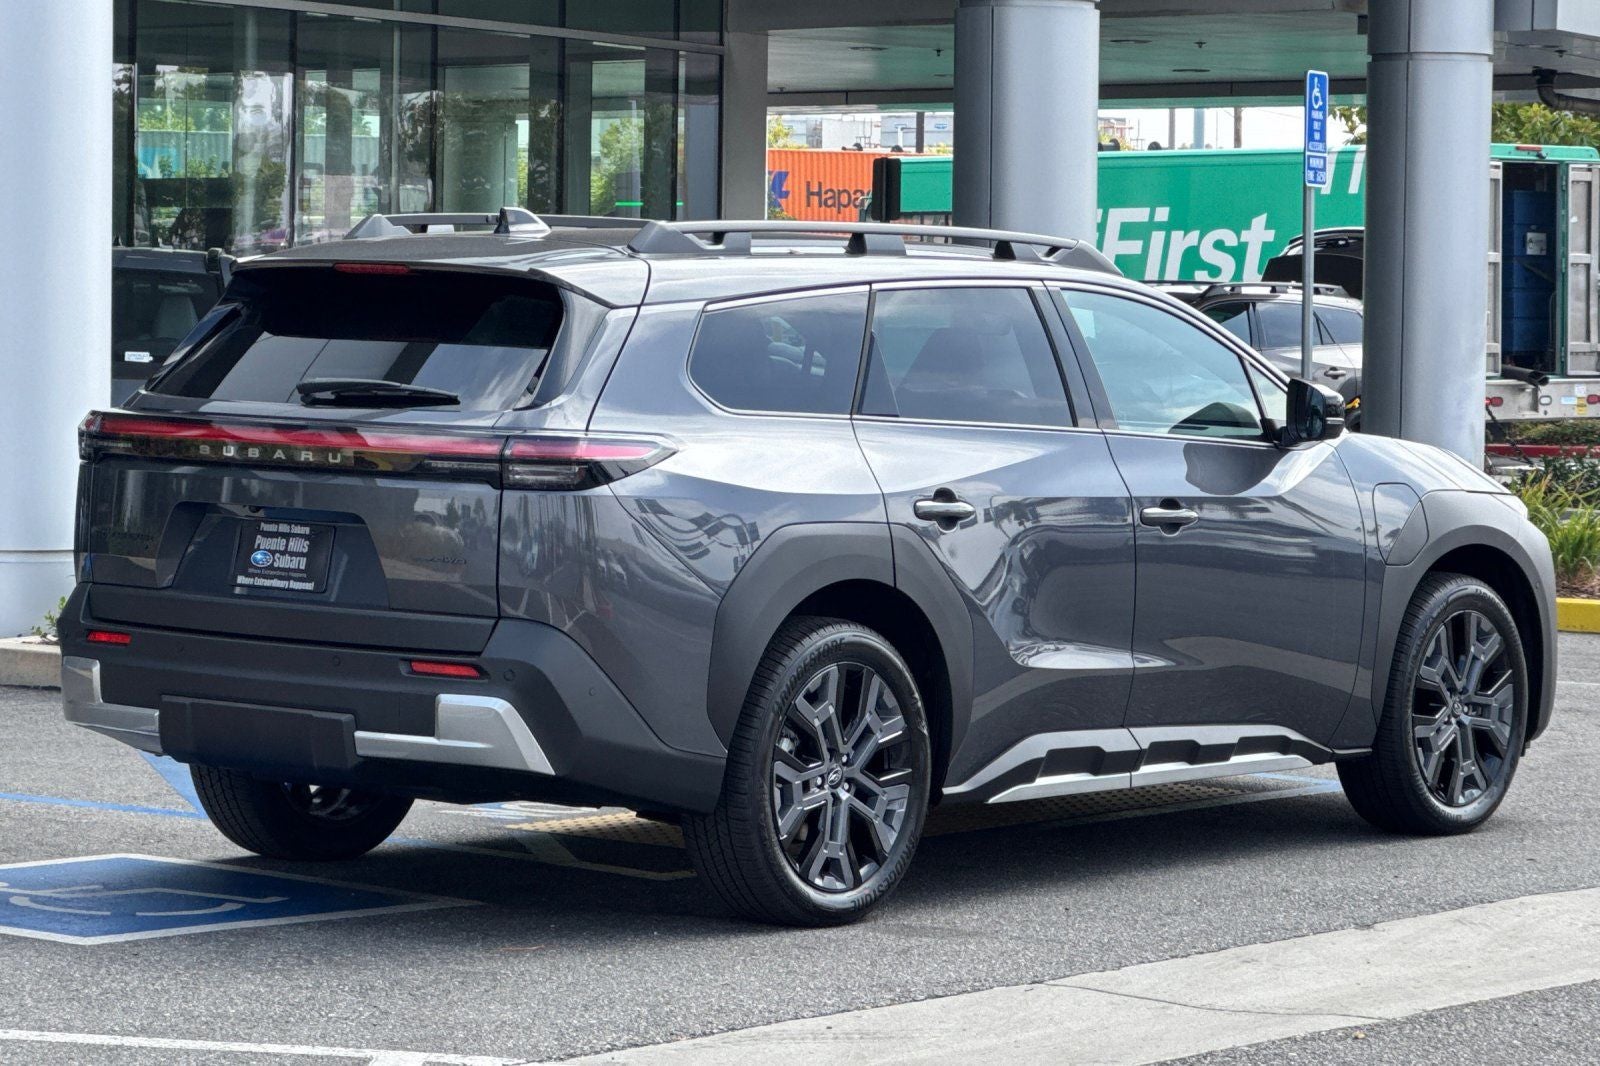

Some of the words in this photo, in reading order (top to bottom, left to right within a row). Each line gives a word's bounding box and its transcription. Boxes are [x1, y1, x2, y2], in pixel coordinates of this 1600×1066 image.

[805, 181, 872, 214] Hapa
[1096, 206, 1275, 282] First
[199, 445, 341, 462] SUBARU
[291, 525, 310, 534] Subaru
[254, 535, 287, 551] Puente
[287, 537, 310, 553] Hills
[273, 553, 306, 569] Subaru
[237, 575, 253, 584] Where
[254, 577, 288, 588] Extraordinary
[289, 580, 314, 590] Happens!
